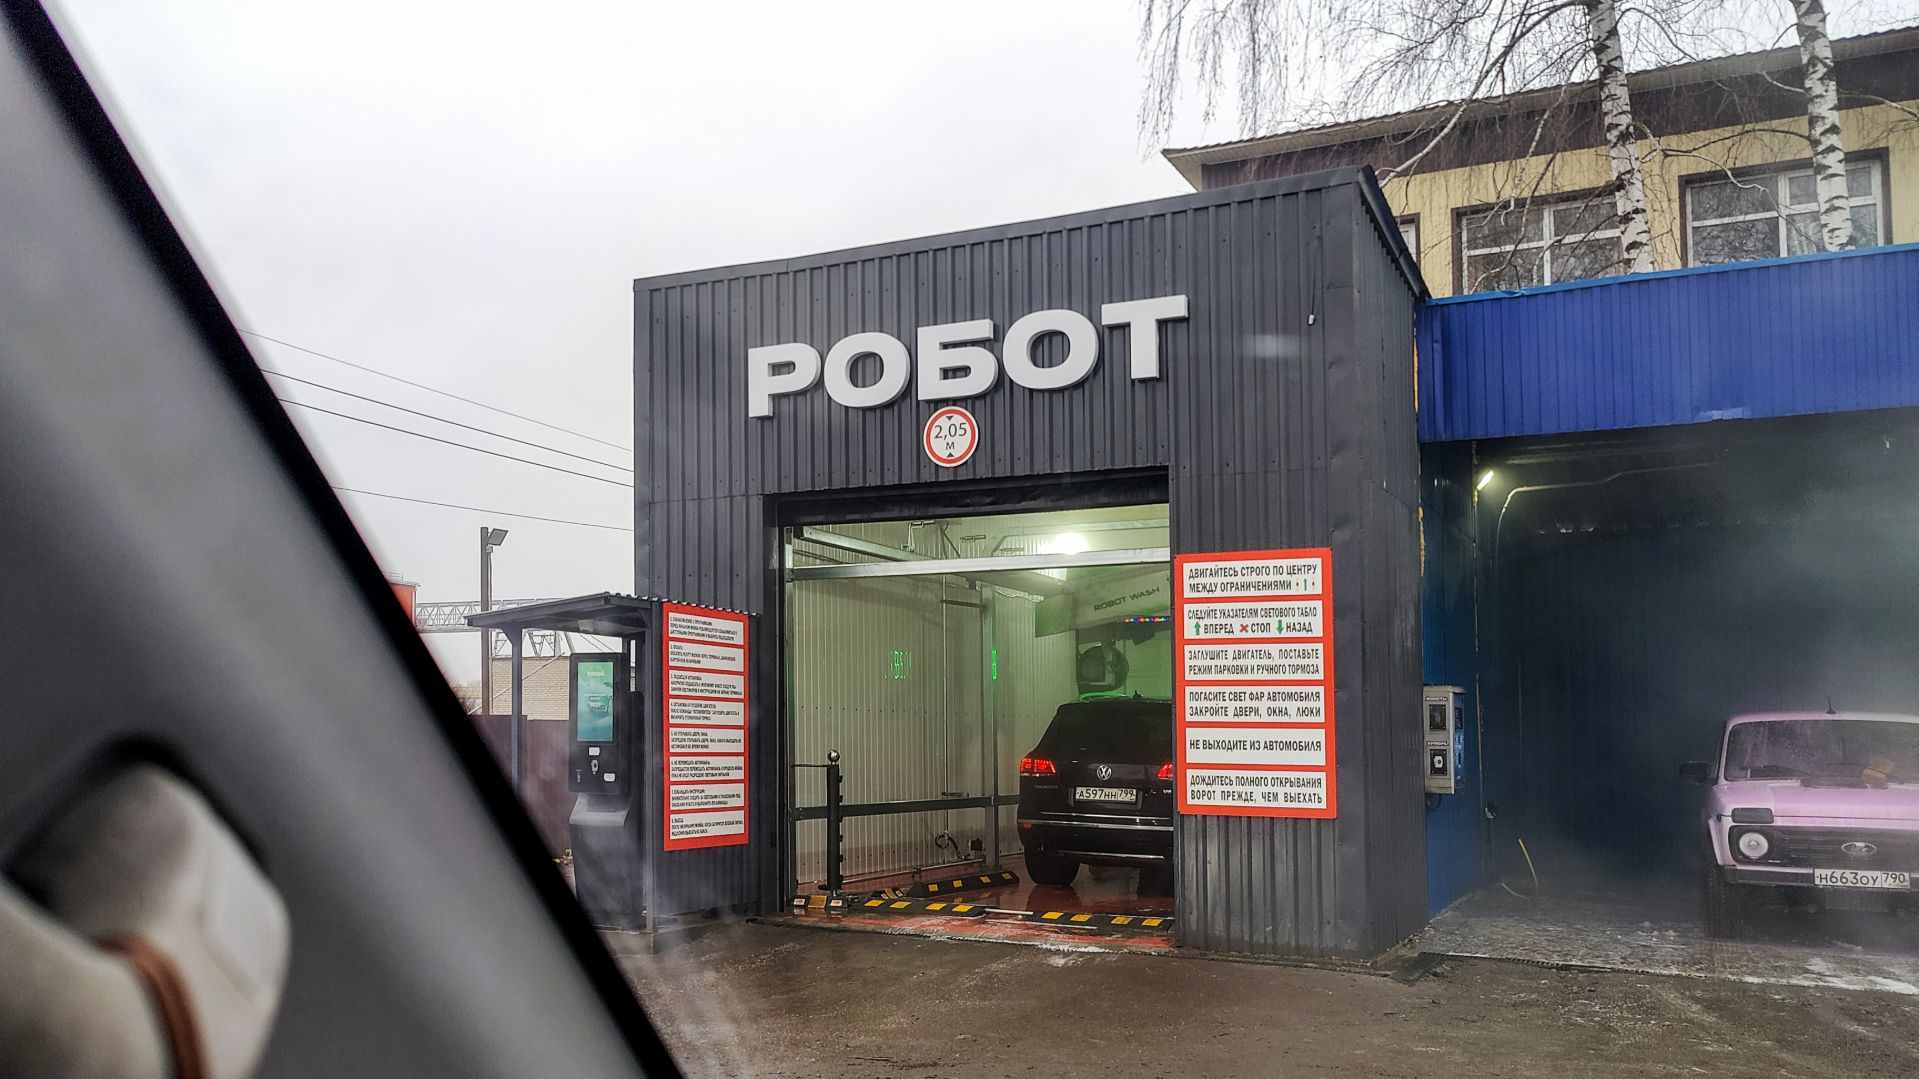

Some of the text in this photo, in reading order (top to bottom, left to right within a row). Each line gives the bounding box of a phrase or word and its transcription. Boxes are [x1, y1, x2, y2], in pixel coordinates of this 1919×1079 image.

[748, 295, 1188, 418] РОБОТ
[934, 423, 967, 440] 2,05
[1189, 564, 1317, 580] ДВИГАЙТЕСЬ СТРОГО ПО ЦЕНТРУ
[1189, 580, 1291, 594] МЕЖДУ ОГРАНИЧЕНИЯМИ
[1094, 586, 1160, 611] ROBOT WASH
[1188, 607, 1317, 621] СЛЕДУЙТЕ УКАЗАТЕЛЯМ СВЕТОВОГО ТАБЛО
[1204, 622, 1313, 635] ВПЕРЕД СТОП НАЗАД
[1189, 649, 1319, 662] ЗАГЛУШИТЕ ДВИГАТЕЛЬ, ПОСТАВЬТЕ
[1189, 664, 1319, 675] РЕЖИМ ПАРКОВКИ И РУЧНОГО ТОРМОЗА
[1189, 692, 1320, 702] ПОГАСИТЕ СВЕТ ФАР АВТОМОБИЛЯ
[1189, 704, 1320, 719] ЗАКРОЙТЕ ДВЕРИ, ОКНА, ЛЮКИ
[1190, 740, 1321, 752] НЕ ВЫХОДИТЕ ИЗ АВТОМОБИЛЯ
[1191, 775, 1321, 788] ДОЖДИТЕСЬ ПОЛНОГО ОТКРЫВАНИЯ
[1191, 790, 1322, 804] ВОРОТ ПРЕЖДЕ, ЧЕМ ВЫЕХАТЬ
[1883, 873, 1906, 883] 790
